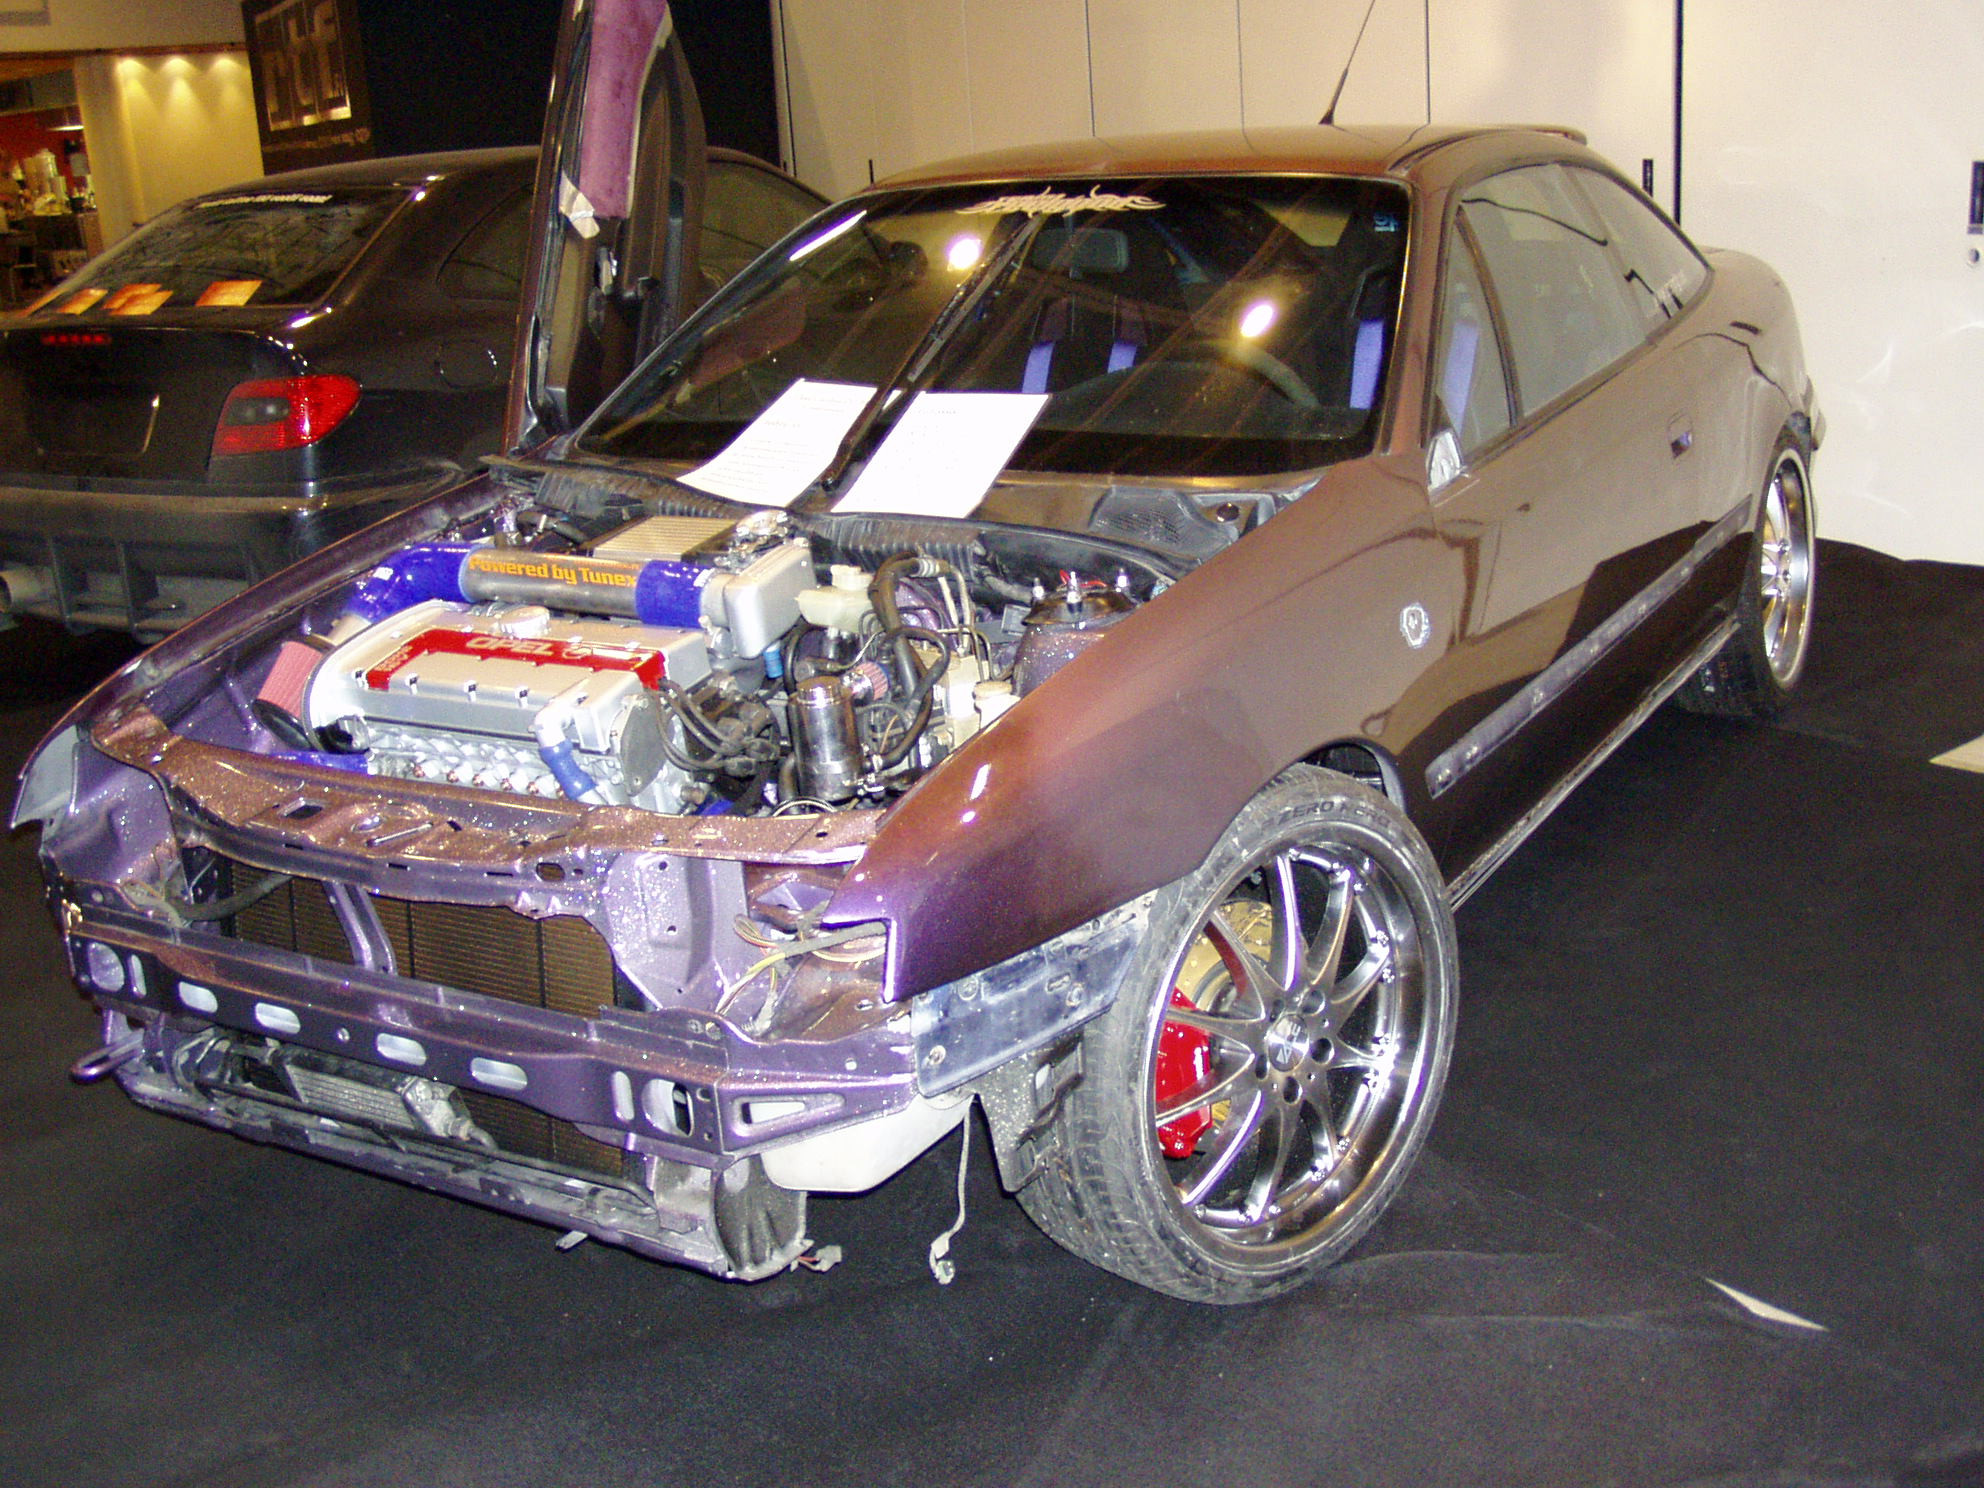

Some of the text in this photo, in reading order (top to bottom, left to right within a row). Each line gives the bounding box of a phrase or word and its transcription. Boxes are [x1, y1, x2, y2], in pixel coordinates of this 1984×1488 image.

[469, 553, 549, 578] Powered
[552, 563, 578, 585] by
[466, 636, 554, 656] OPEL
[1277, 800, 1335, 826] ZERO
